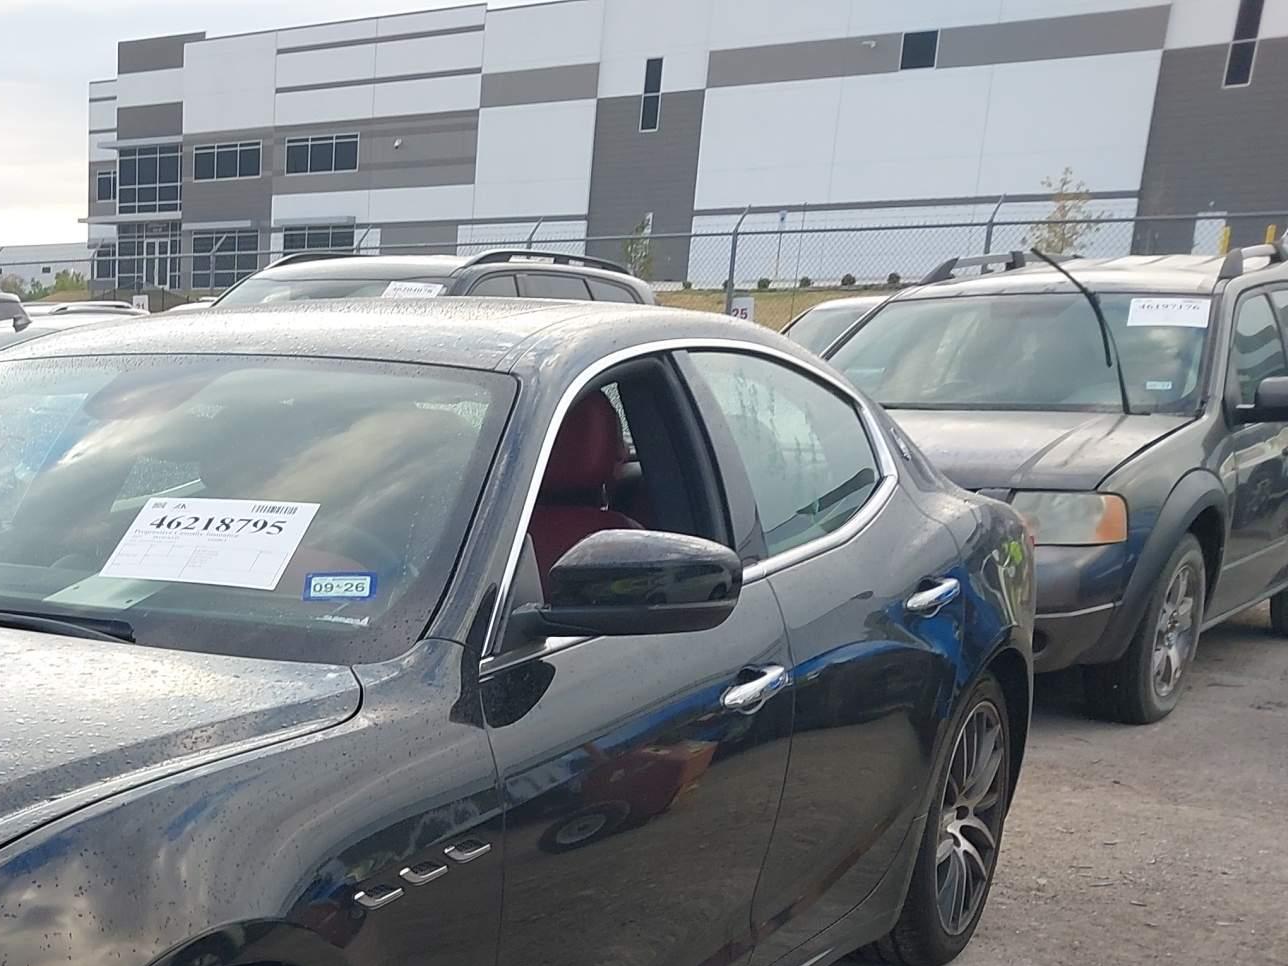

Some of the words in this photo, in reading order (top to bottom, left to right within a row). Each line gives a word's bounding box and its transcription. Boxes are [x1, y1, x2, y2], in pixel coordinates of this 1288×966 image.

[732, 307, 748, 320] 25
[149, 513, 288, 536] 46218795
[313, 582, 334, 593] 09
[344, 582, 365, 593] 26
